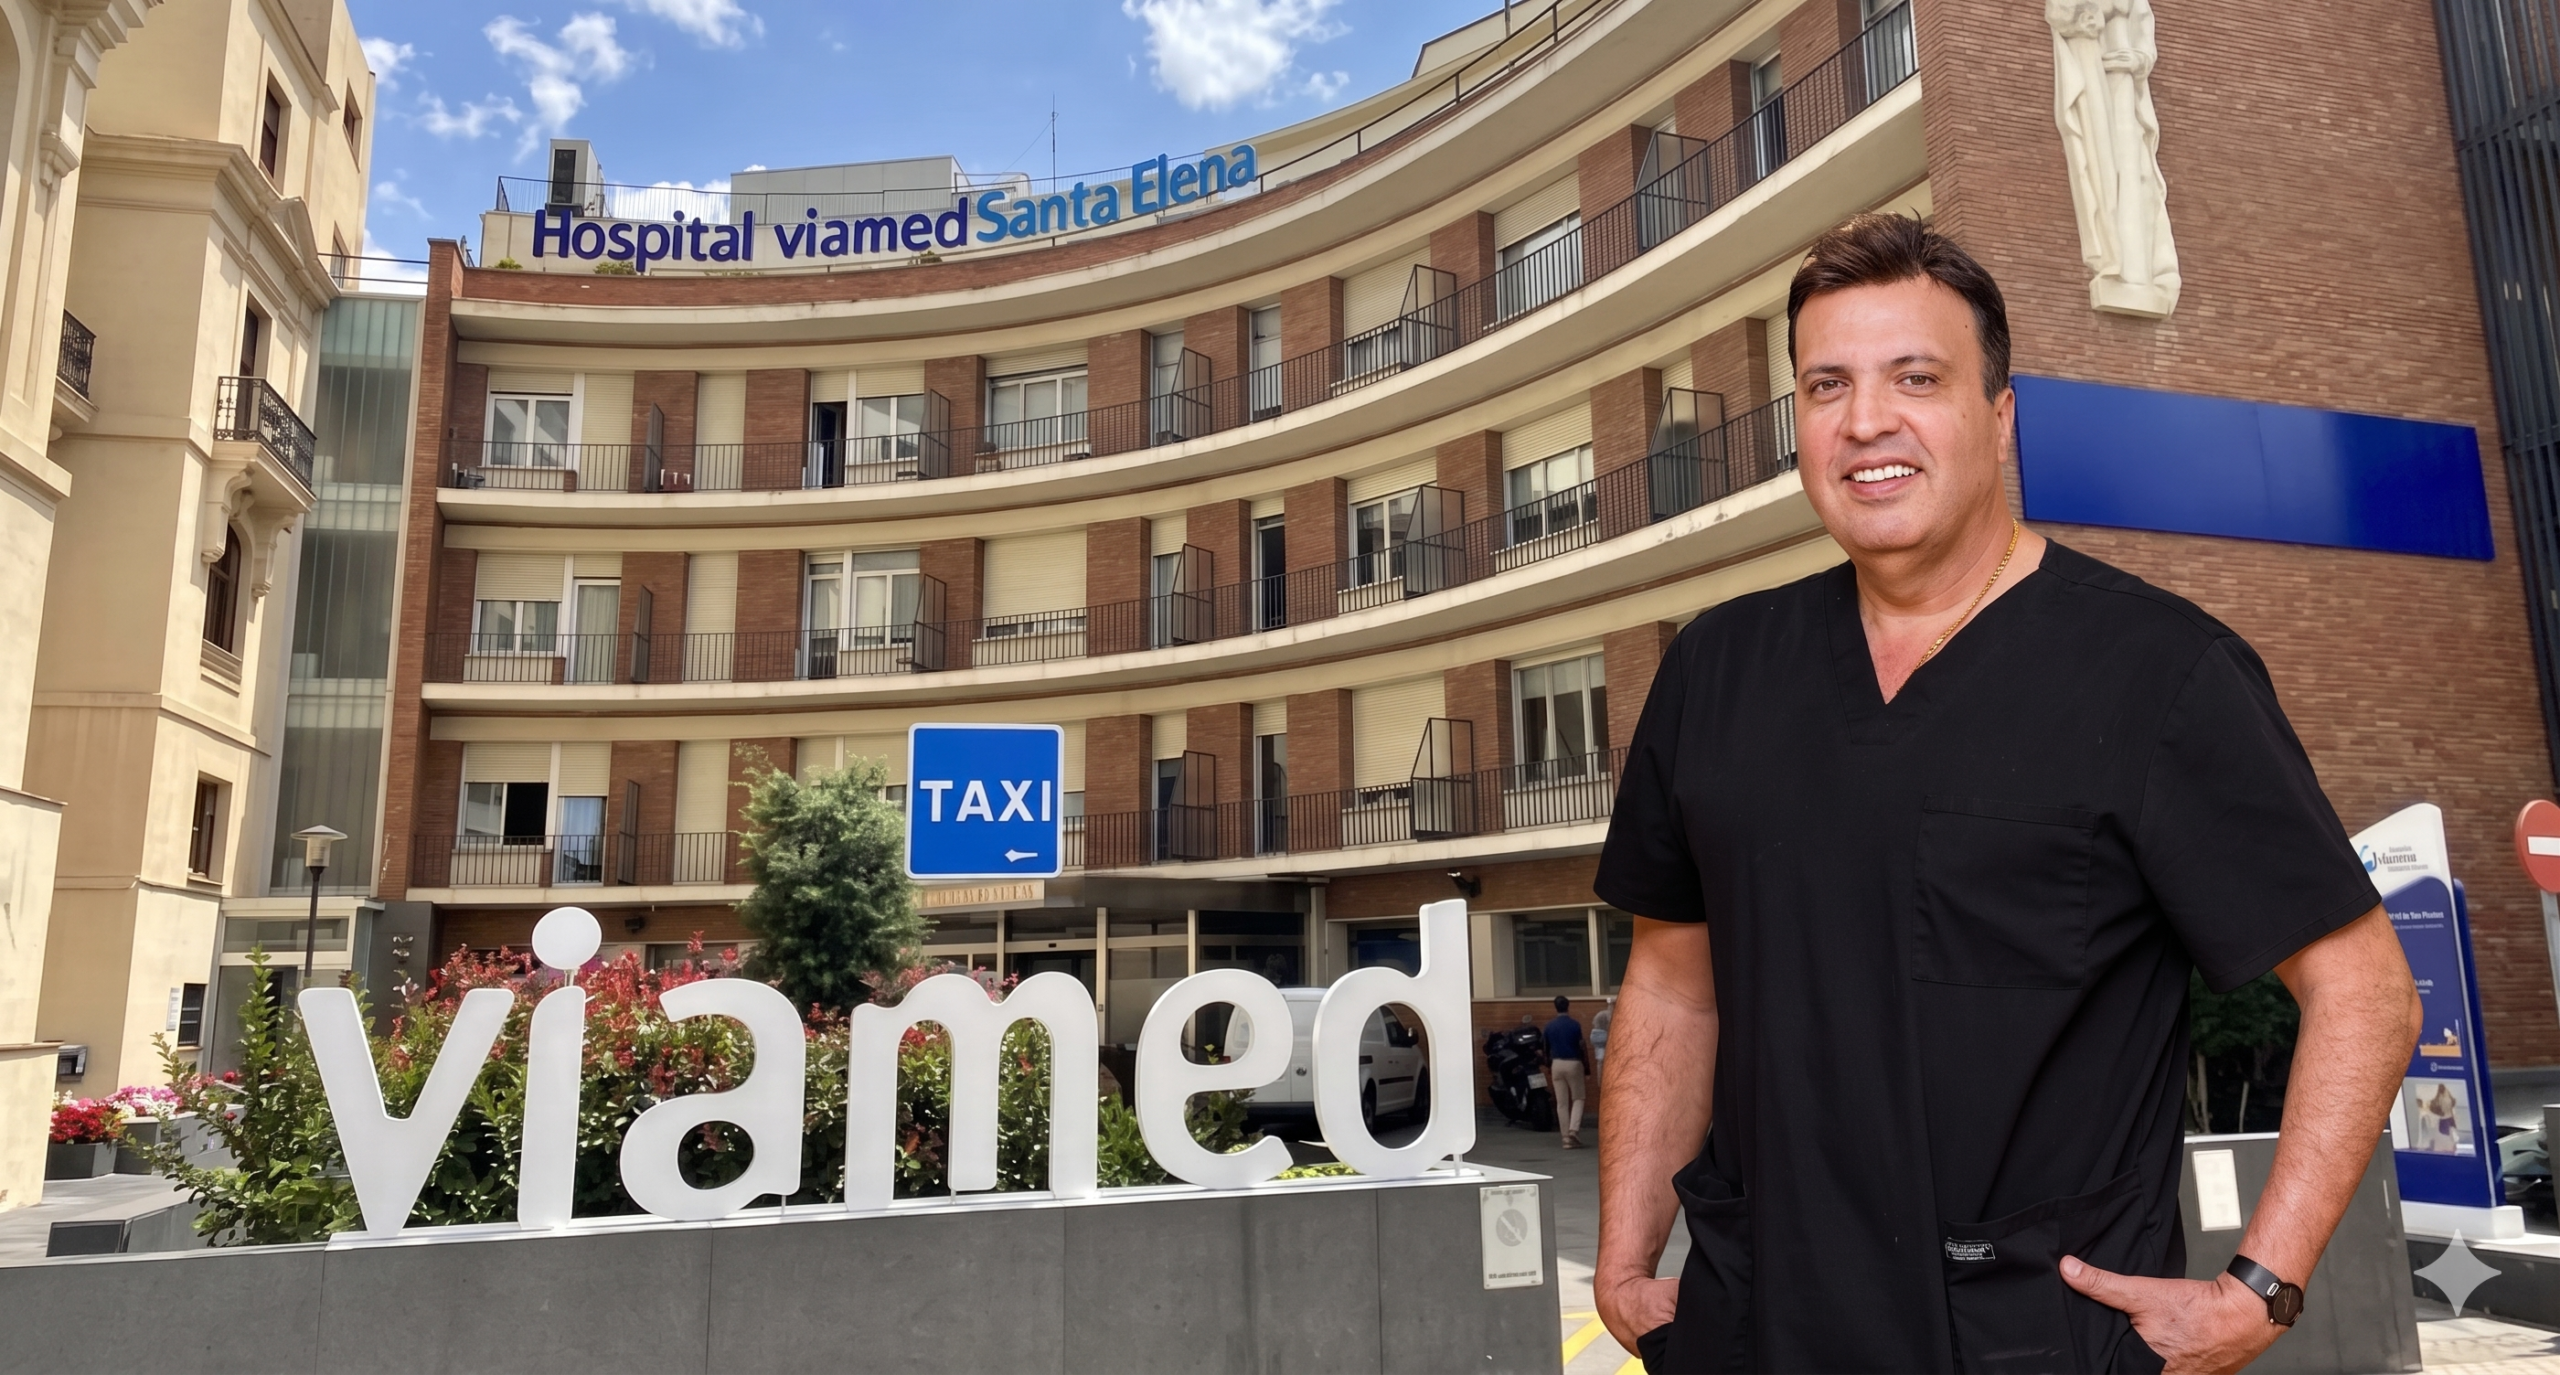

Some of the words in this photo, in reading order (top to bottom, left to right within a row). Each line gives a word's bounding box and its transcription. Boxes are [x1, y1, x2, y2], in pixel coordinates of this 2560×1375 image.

[532, 208, 755, 272] Hospital
[774, 196, 969, 260] viamed
[976, 181, 1120, 242] Santa
[1132, 143, 1258, 215] Elena
[919, 780, 1051, 822] TAXI
[299, 897, 1477, 1238] viamed
